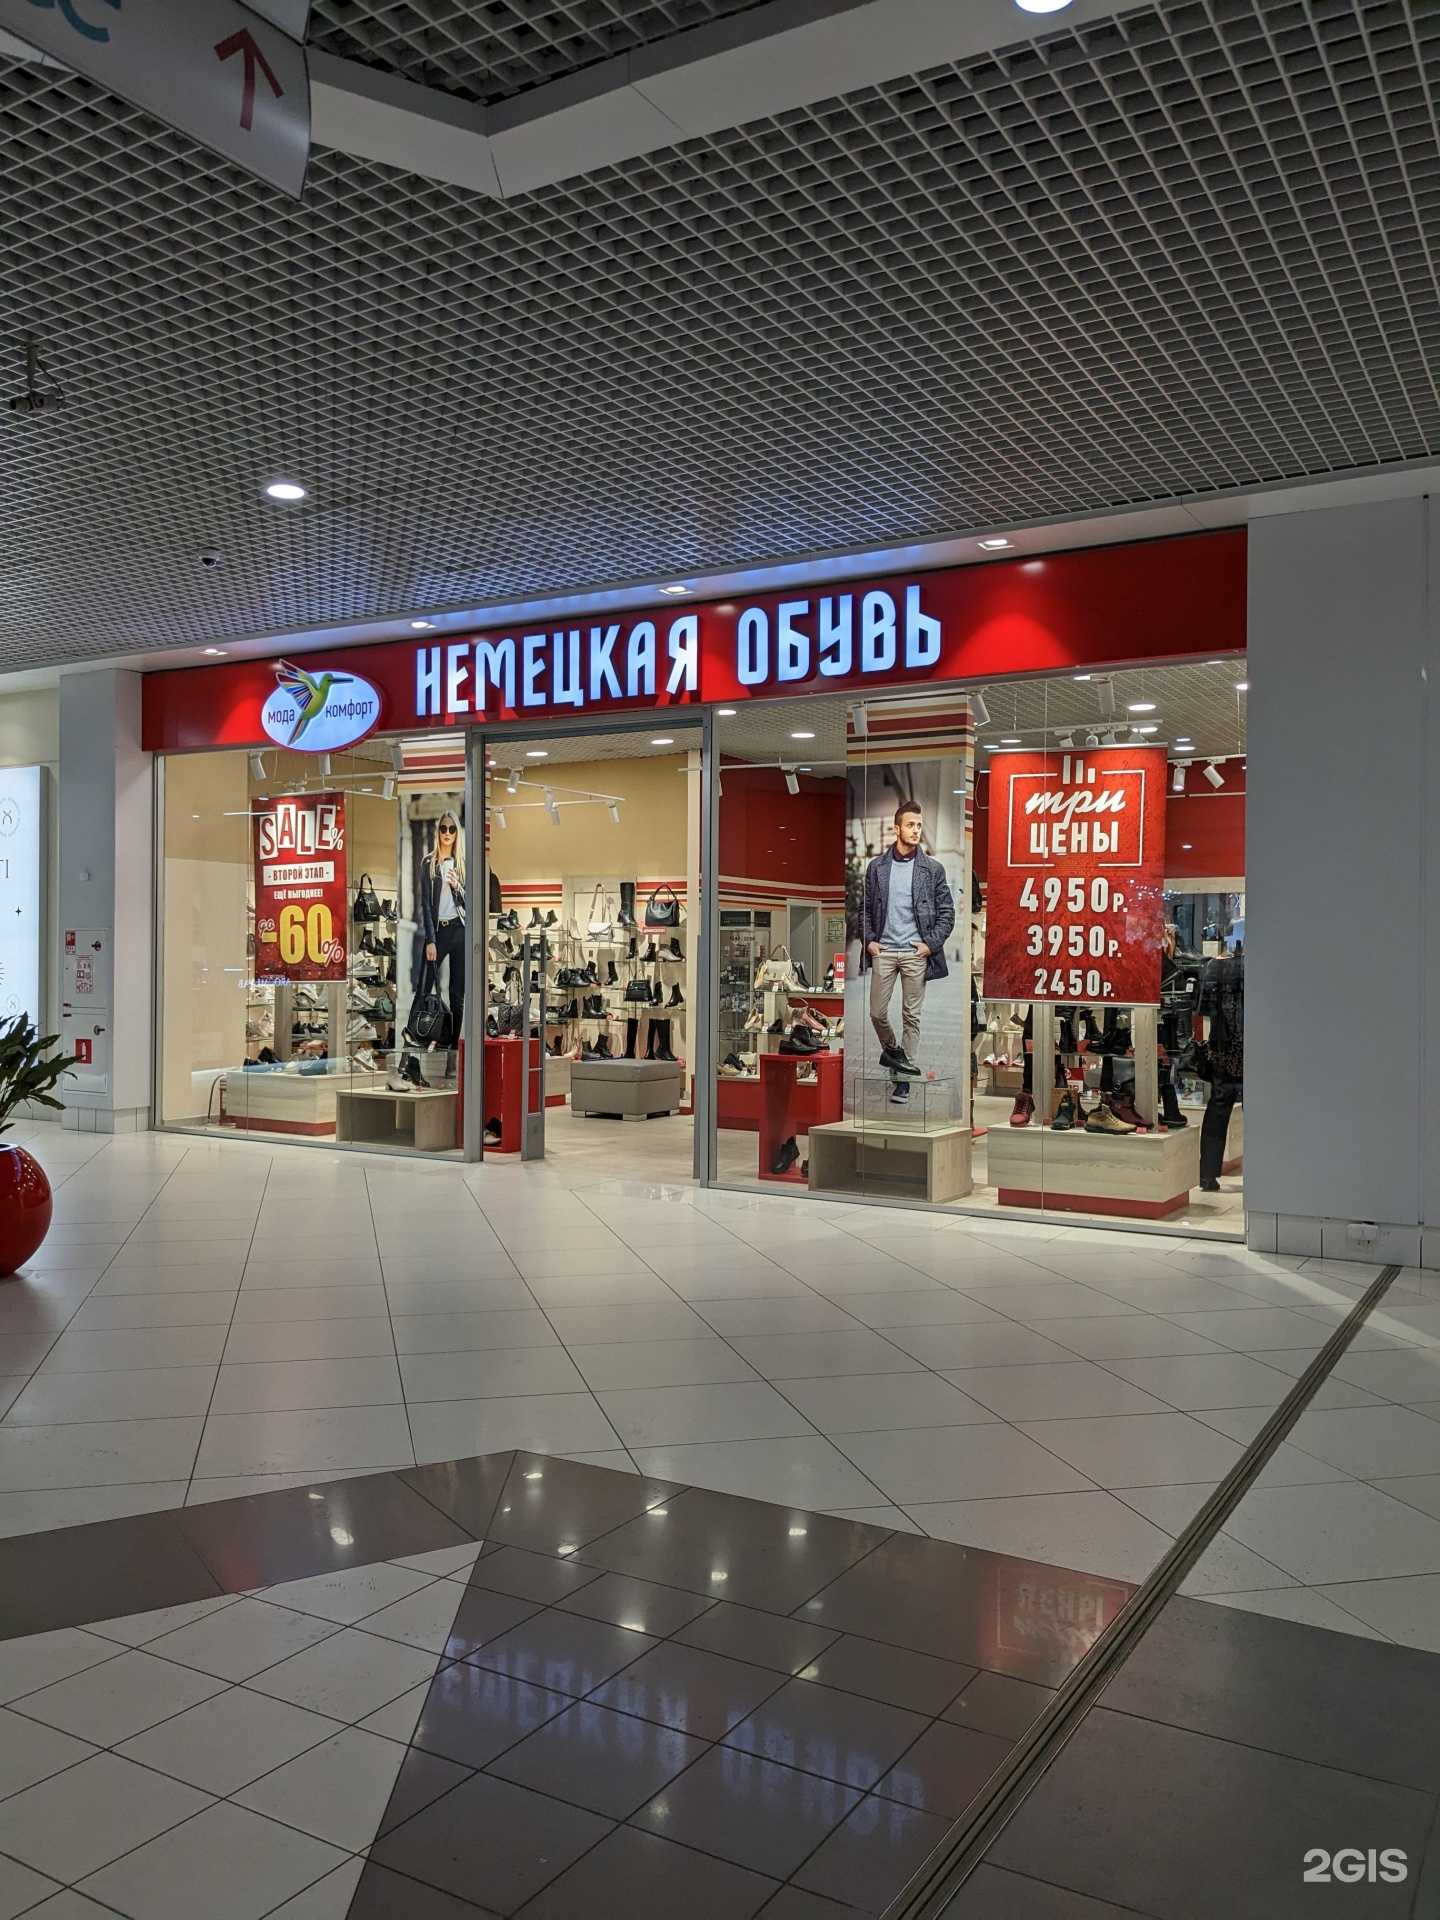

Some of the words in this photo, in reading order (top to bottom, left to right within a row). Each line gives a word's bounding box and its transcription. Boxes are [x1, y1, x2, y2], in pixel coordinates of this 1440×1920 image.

[416, 615, 698, 717] НЕМЕЦКАЯ
[737, 584, 942, 685] ОБУВЬ
[267, 708, 295, 725] мода
[325, 698, 374, 720] комфорт
[1025, 789, 1126, 830] три
[1029, 821, 1119, 859] ЦЕНЫ
[273, 867, 303, 881] ВТОРОЙ
[304, 866, 324, 880] ЭТАП
